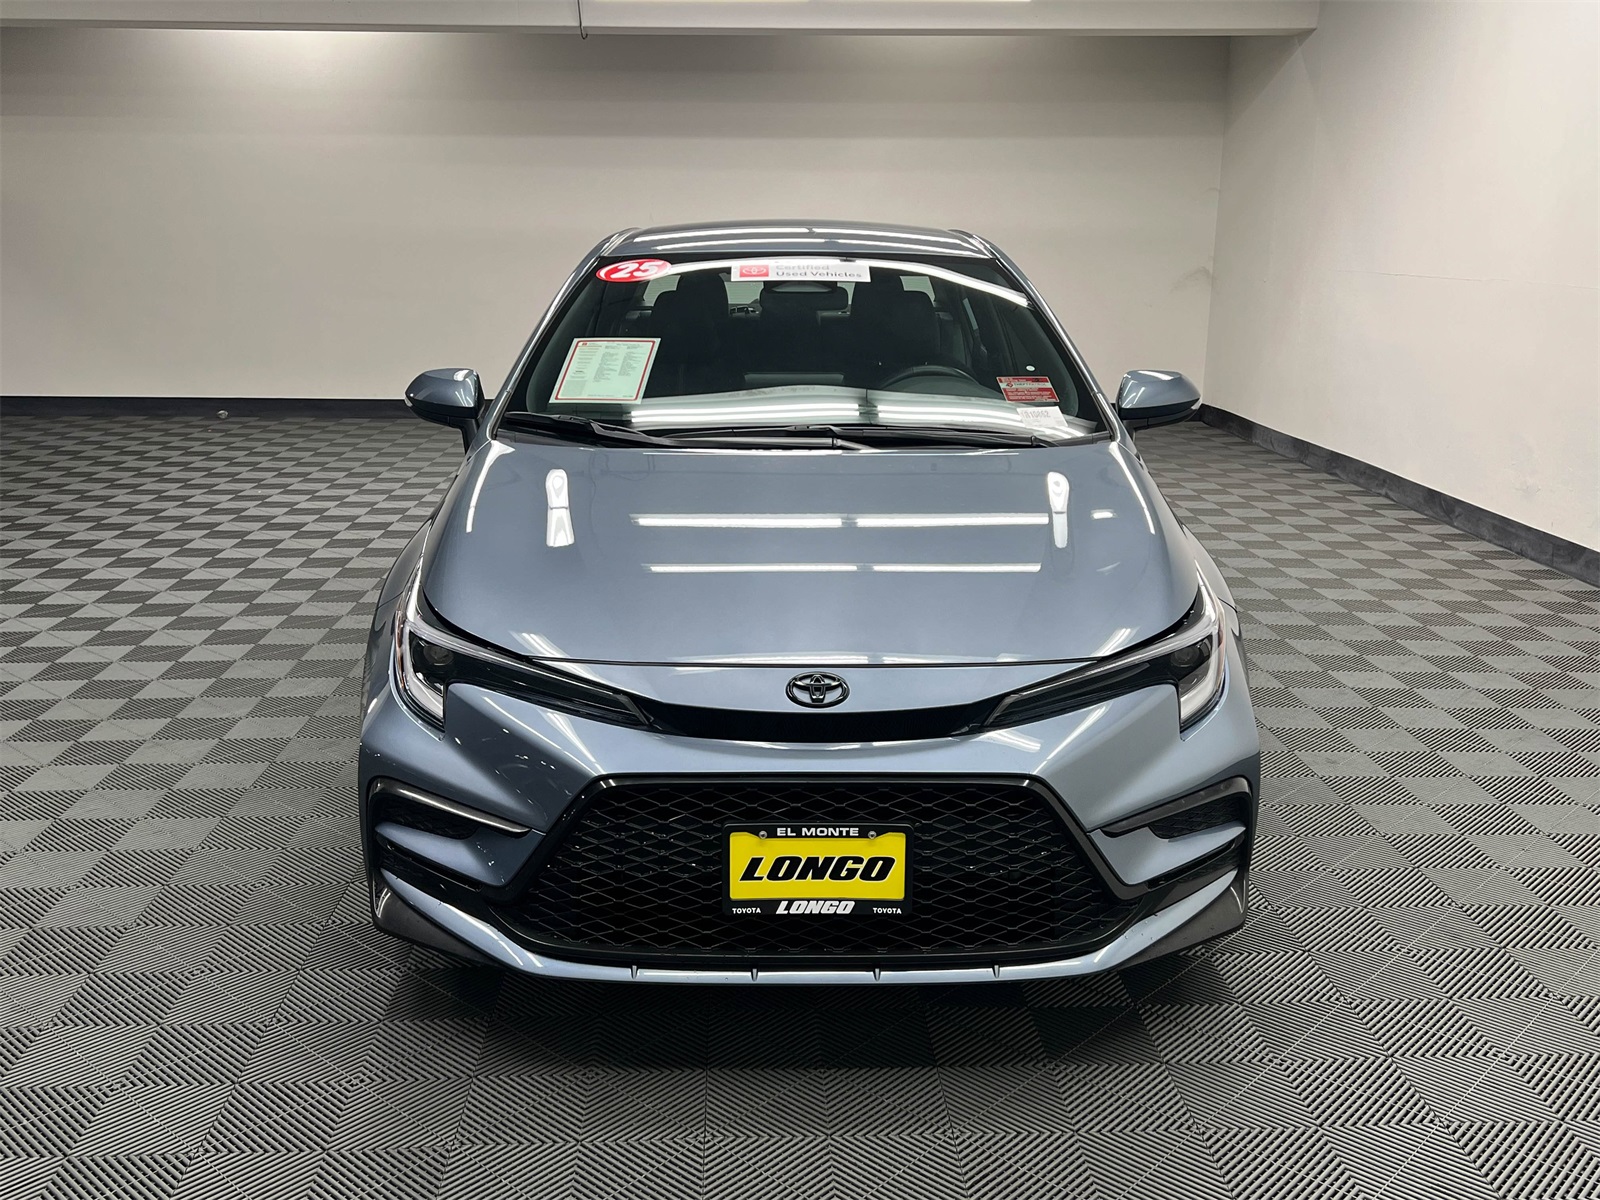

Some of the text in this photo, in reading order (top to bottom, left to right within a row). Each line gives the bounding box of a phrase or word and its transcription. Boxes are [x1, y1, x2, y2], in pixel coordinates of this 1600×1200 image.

[609, 261, 665, 279] 25
[810, 270, 862, 278] Vehicles
[776, 827, 860, 837] EL MONTE
[739, 856, 896, 882] LONGO
[775, 900, 856, 915] LONGO
